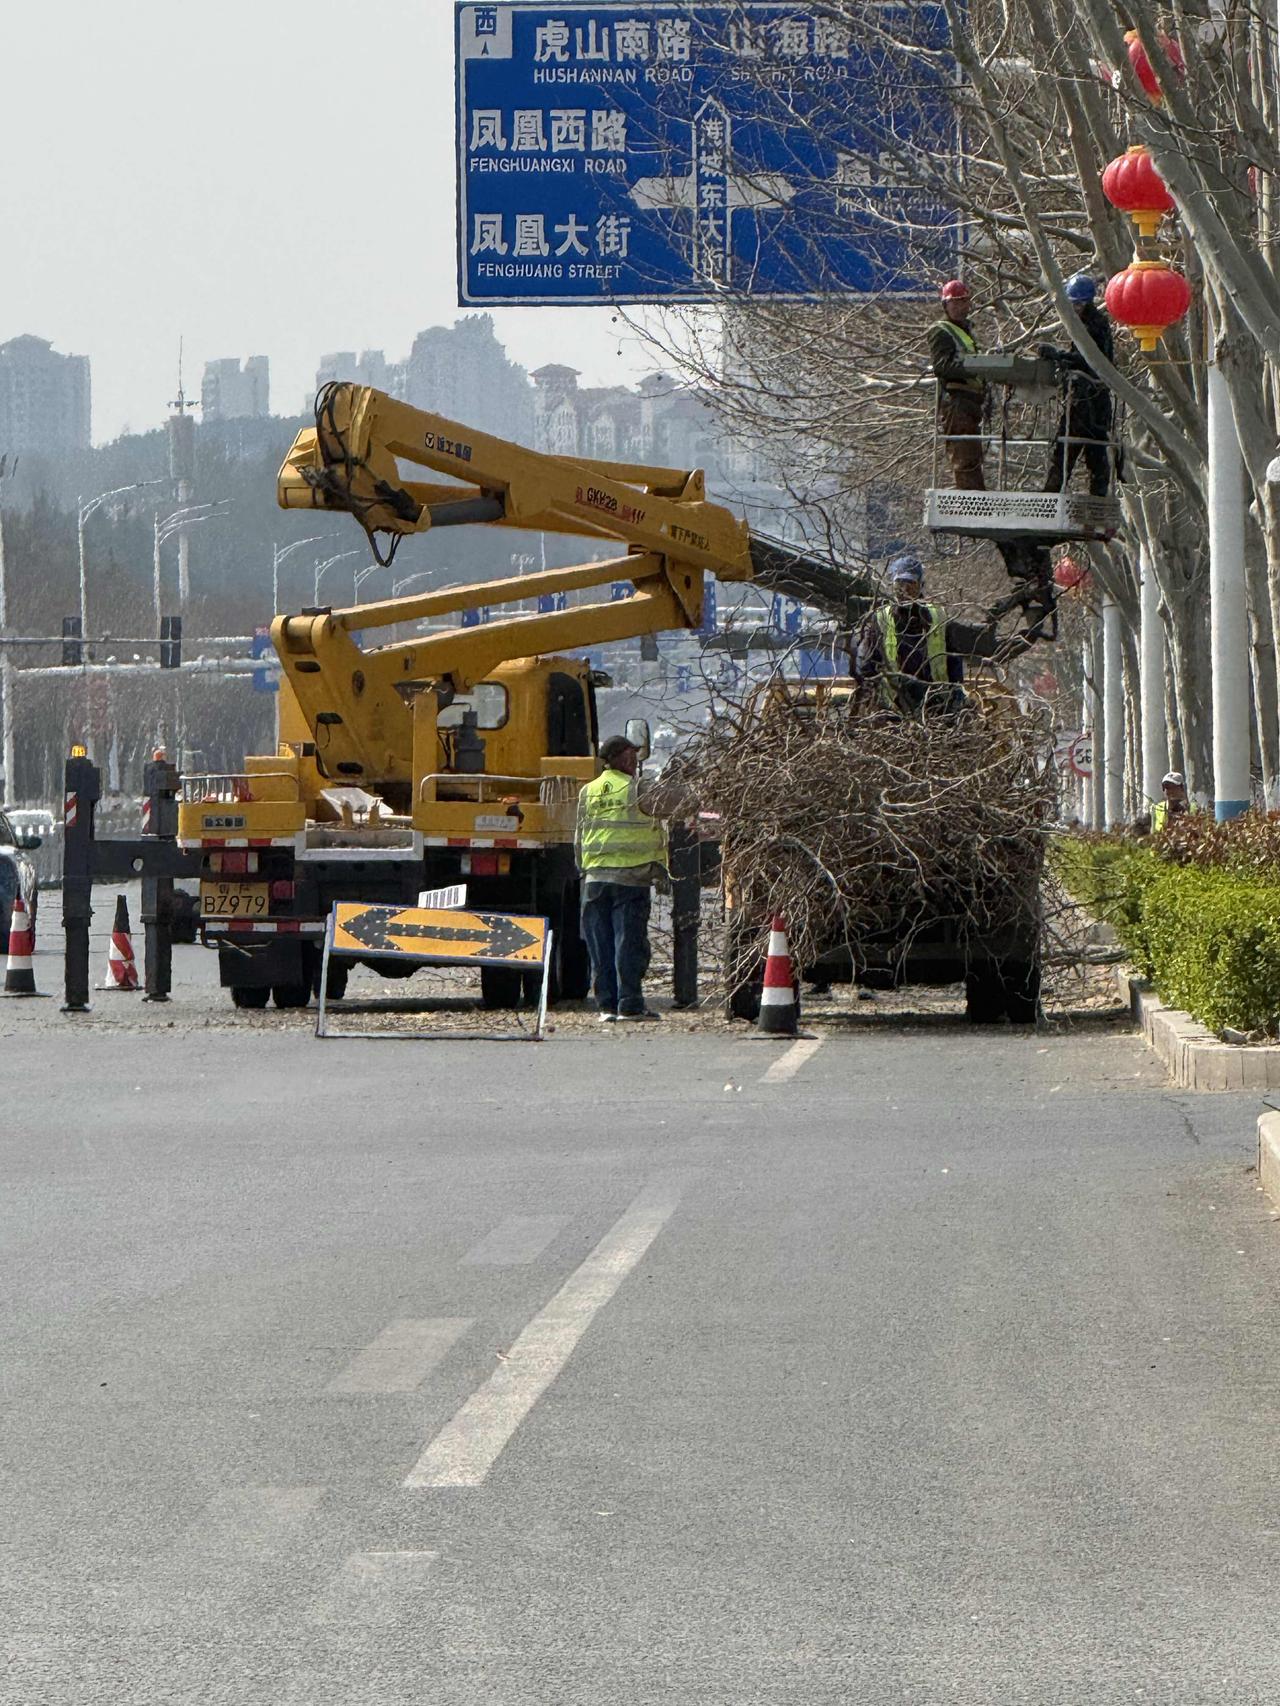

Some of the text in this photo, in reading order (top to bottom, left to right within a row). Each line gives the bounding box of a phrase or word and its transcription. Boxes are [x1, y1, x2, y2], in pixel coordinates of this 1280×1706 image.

[474, 7, 497, 37] 西
[534, 19, 691, 62] 虎山南路
[534, 67, 693, 84] HUSHANNAN ROAD
[469, 109, 626, 152] 凤凰西路
[470, 158, 627, 173] FENGHUANGXI ROAD
[470, 213, 631, 257] 凤凰大街
[477, 263, 622, 279] FENGHUANG STREET
[204, 895, 266, 914] BZ979
